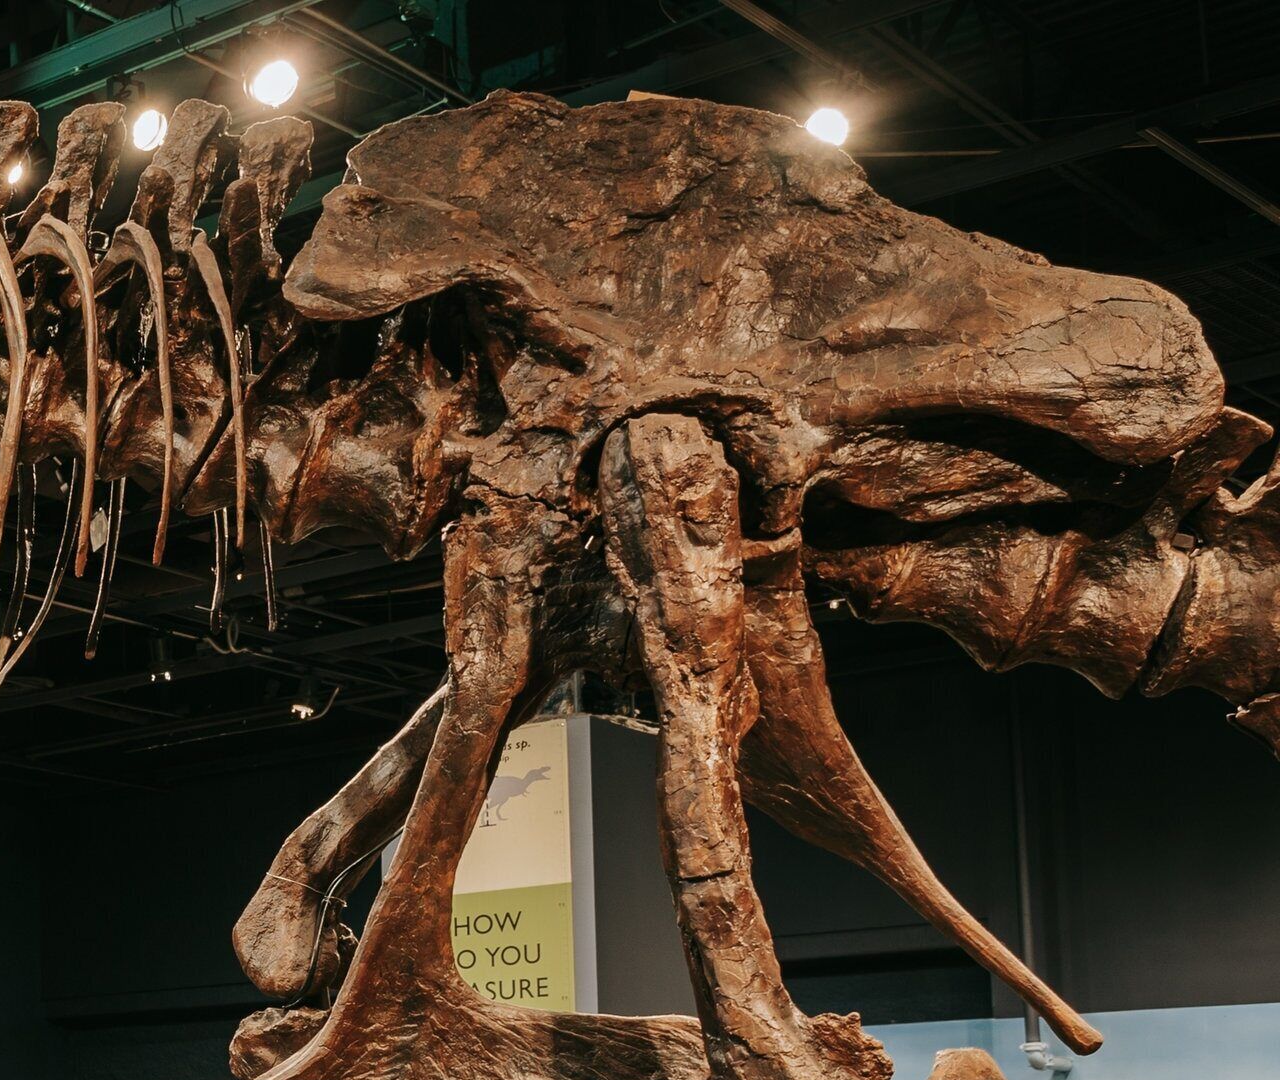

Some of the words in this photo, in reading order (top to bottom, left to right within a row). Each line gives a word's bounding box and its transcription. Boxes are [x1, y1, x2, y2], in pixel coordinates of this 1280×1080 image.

[454, 911, 522, 936] HOW
[457, 950, 476, 969] O
[485, 943, 541, 966] YOU
[472, 977, 549, 1000] SURE
